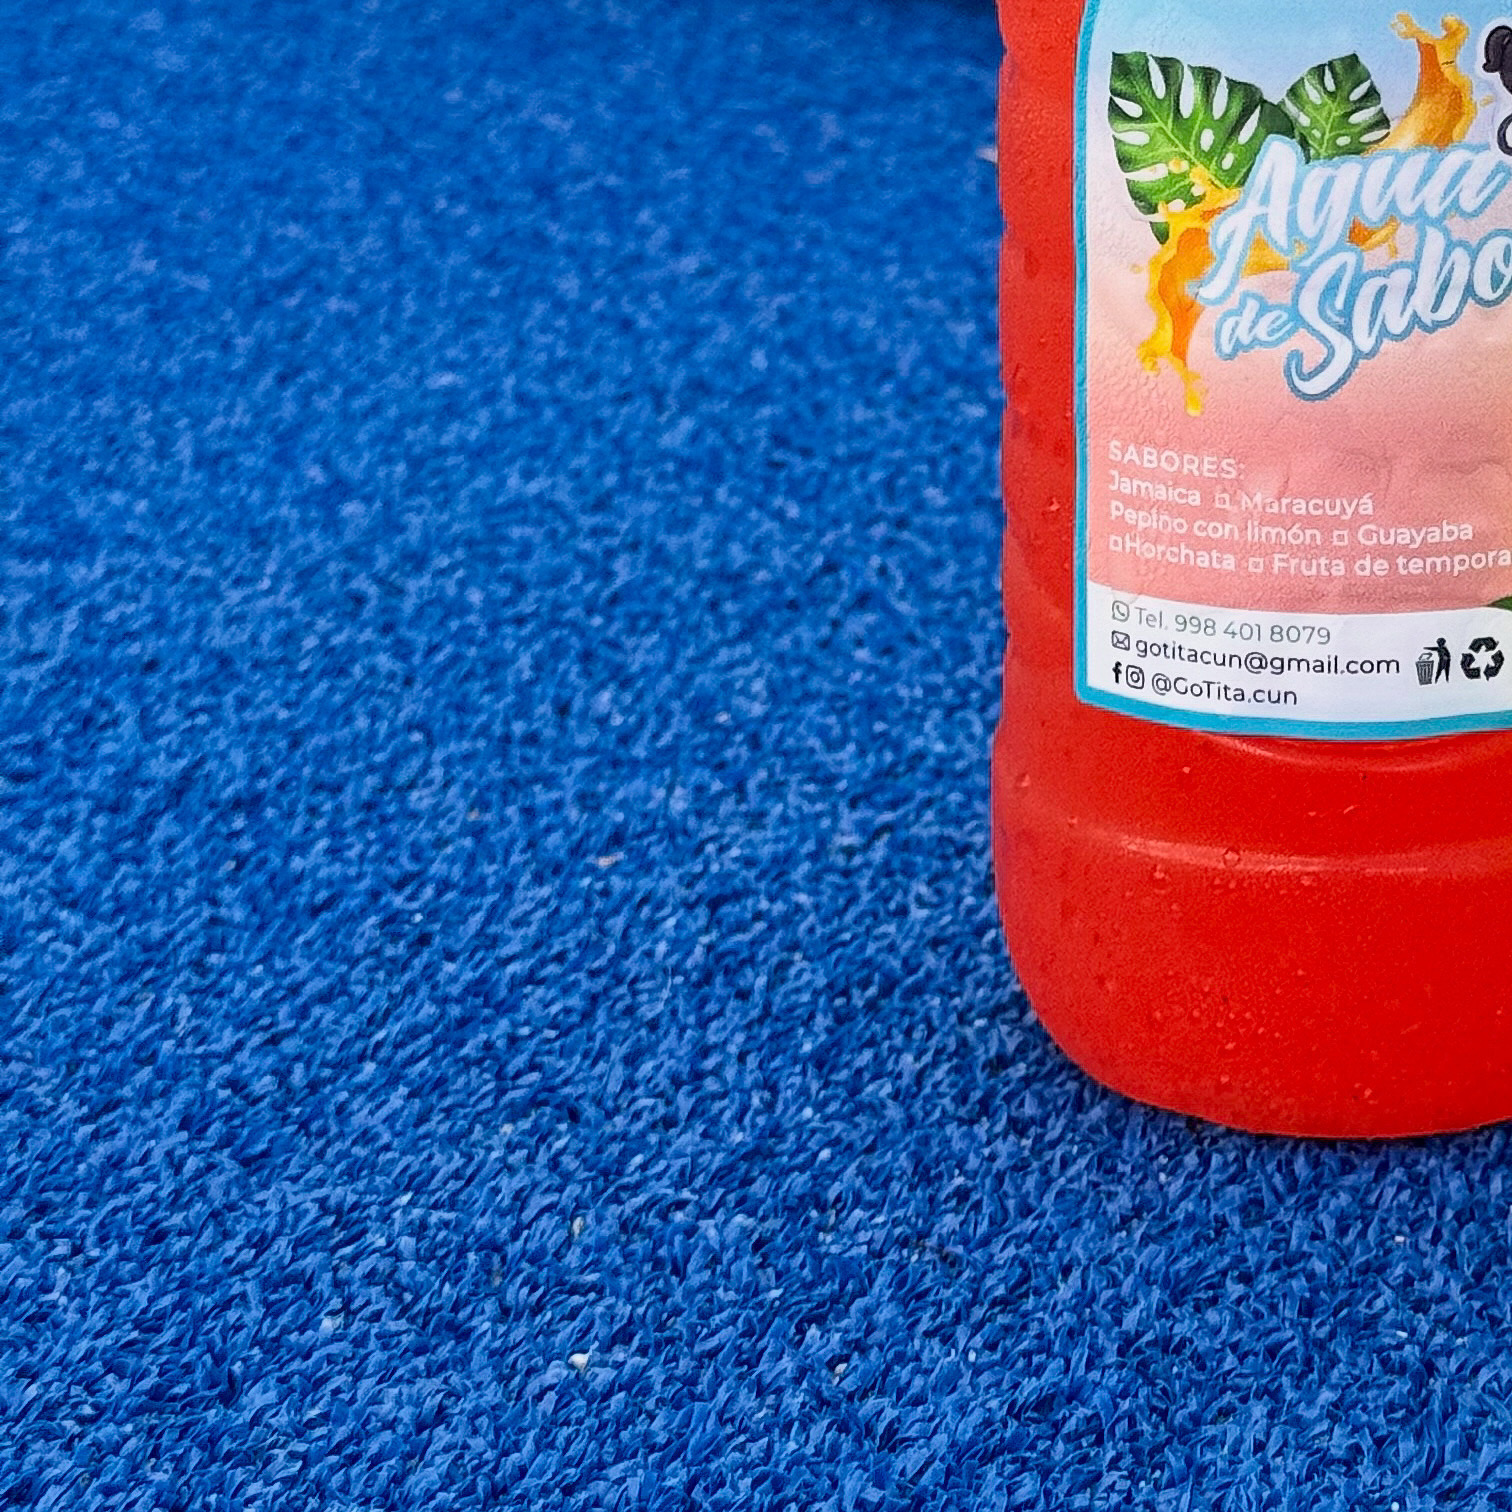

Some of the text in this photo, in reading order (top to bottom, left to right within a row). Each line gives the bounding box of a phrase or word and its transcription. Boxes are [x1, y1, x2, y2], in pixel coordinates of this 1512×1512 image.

[1199, 139, 1507, 301] Agua
[1220, 298, 1291, 352] de
[1108, 440, 1246, 480] SABORES:
[1108, 470, 1374, 520] Jamaica Maracuyá
[1109, 499, 1474, 549] Pepino con limón Guayaba
[1273, 553, 1346, 577] Fruta
[1354, 554, 1390, 577] de
[1134, 606, 1332, 645] Tel. 998 401 8079
[1135, 638, 1400, 675] gotitacun@gmail.com
[1151, 672, 1298, 706] @GoTita.cun
